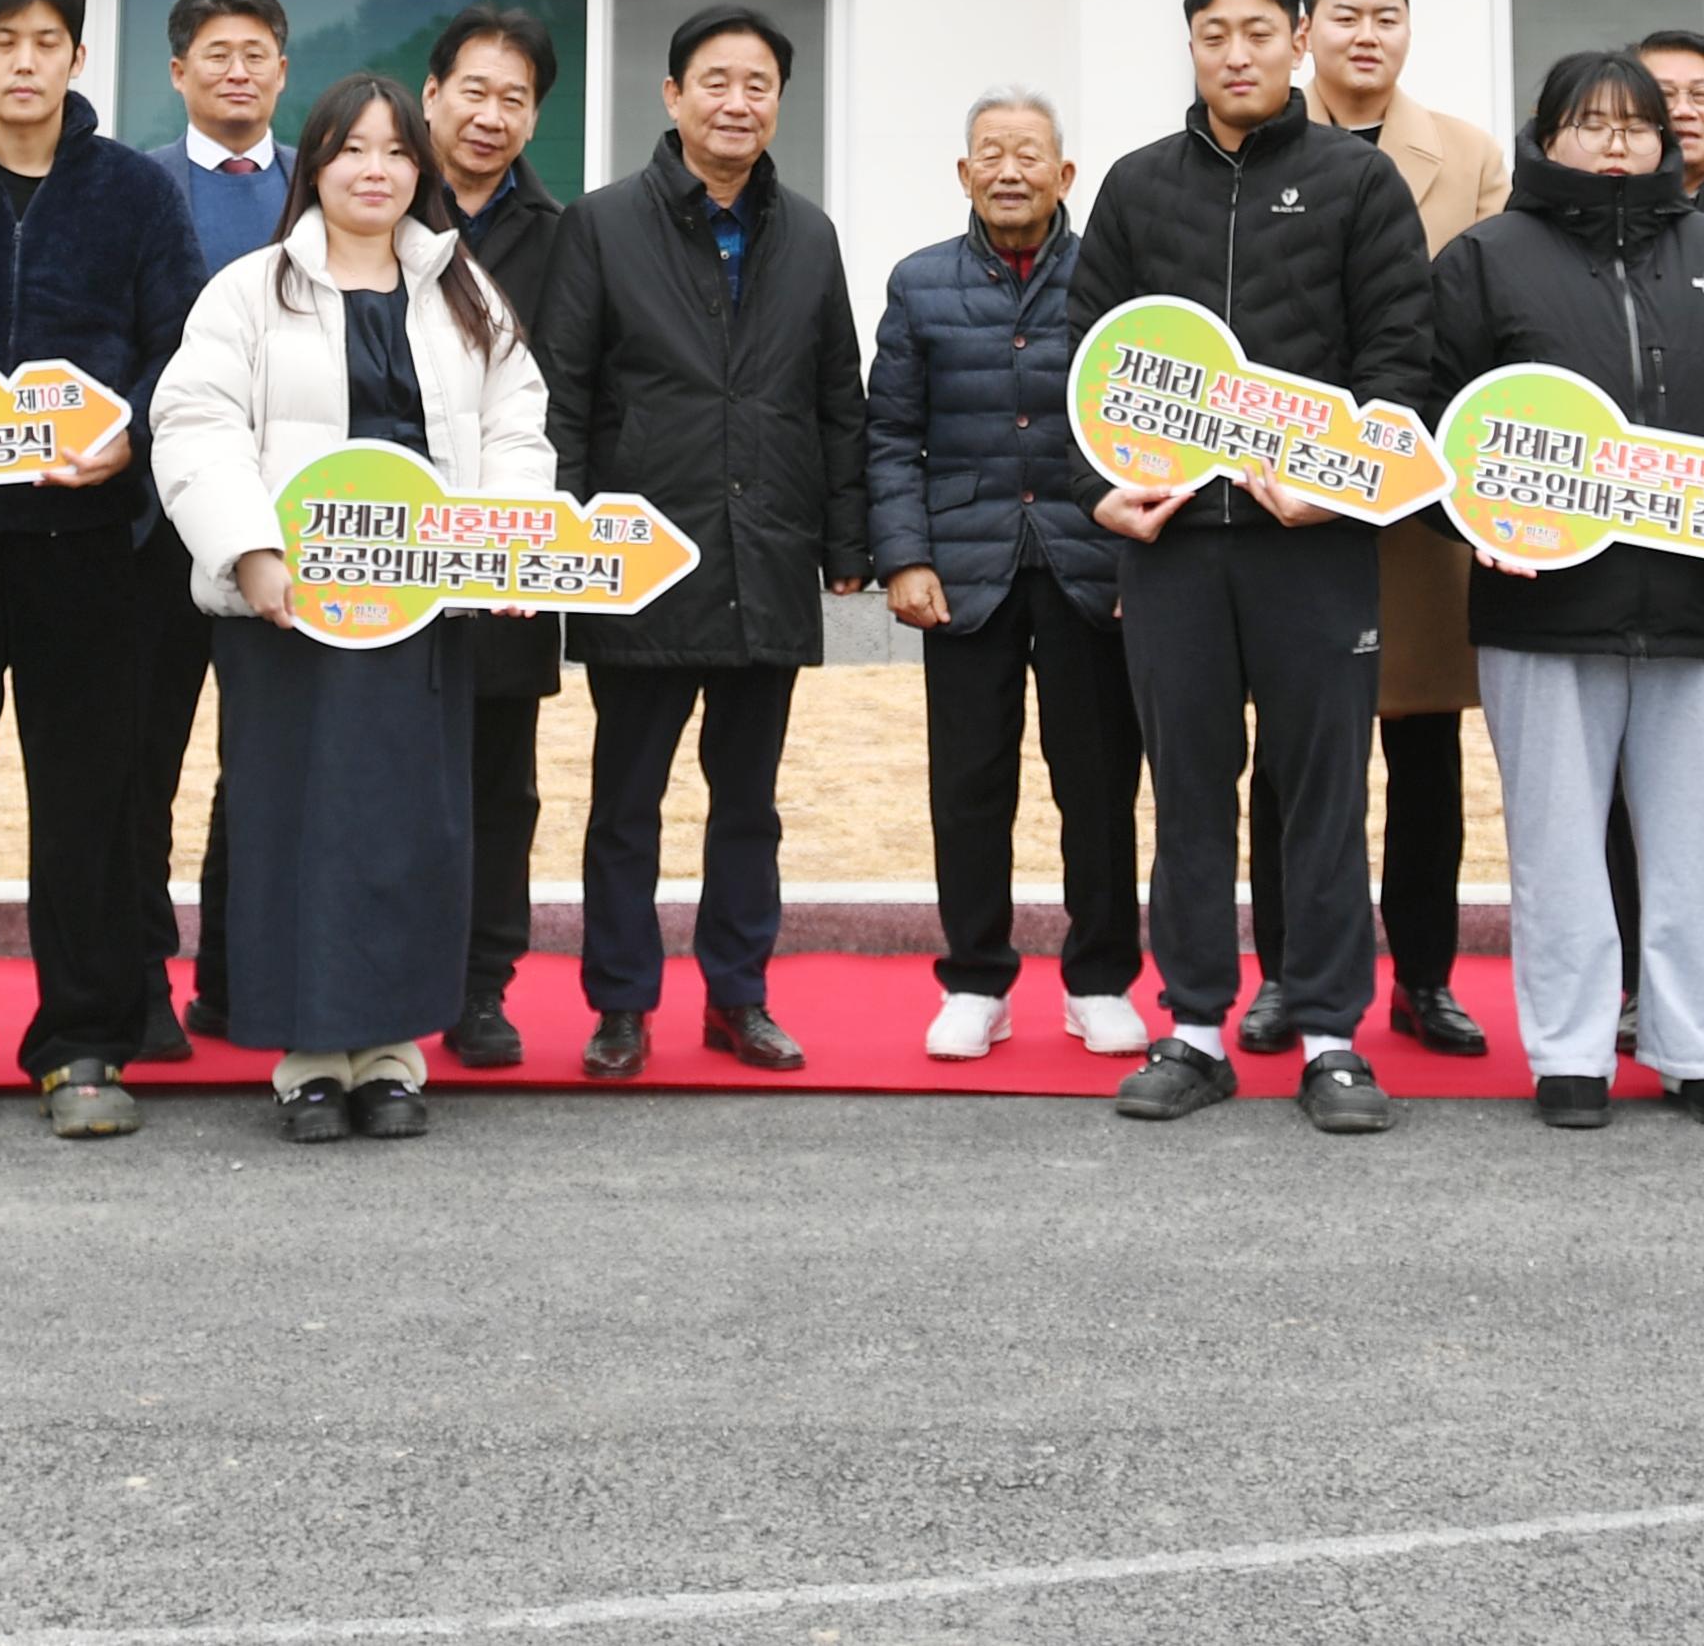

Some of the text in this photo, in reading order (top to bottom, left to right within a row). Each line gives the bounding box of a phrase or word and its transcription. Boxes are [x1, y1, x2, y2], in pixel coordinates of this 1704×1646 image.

[15, 386, 82, 412] 제10호
[1111, 346, 1330, 436] 거례리 신혼부부
[1102, 386, 1381, 499] 공공임대주택 준공식
[1360, 421, 1417, 454] 제6호
[1480, 419, 1582, 467] 거례리
[1476, 459, 1680, 532] 공공임대주택
[301, 503, 554, 546] 거례리 신혼부부
[592, 518, 651, 542] 제7호
[300, 546, 620, 593] 공공임대주택 준공식
